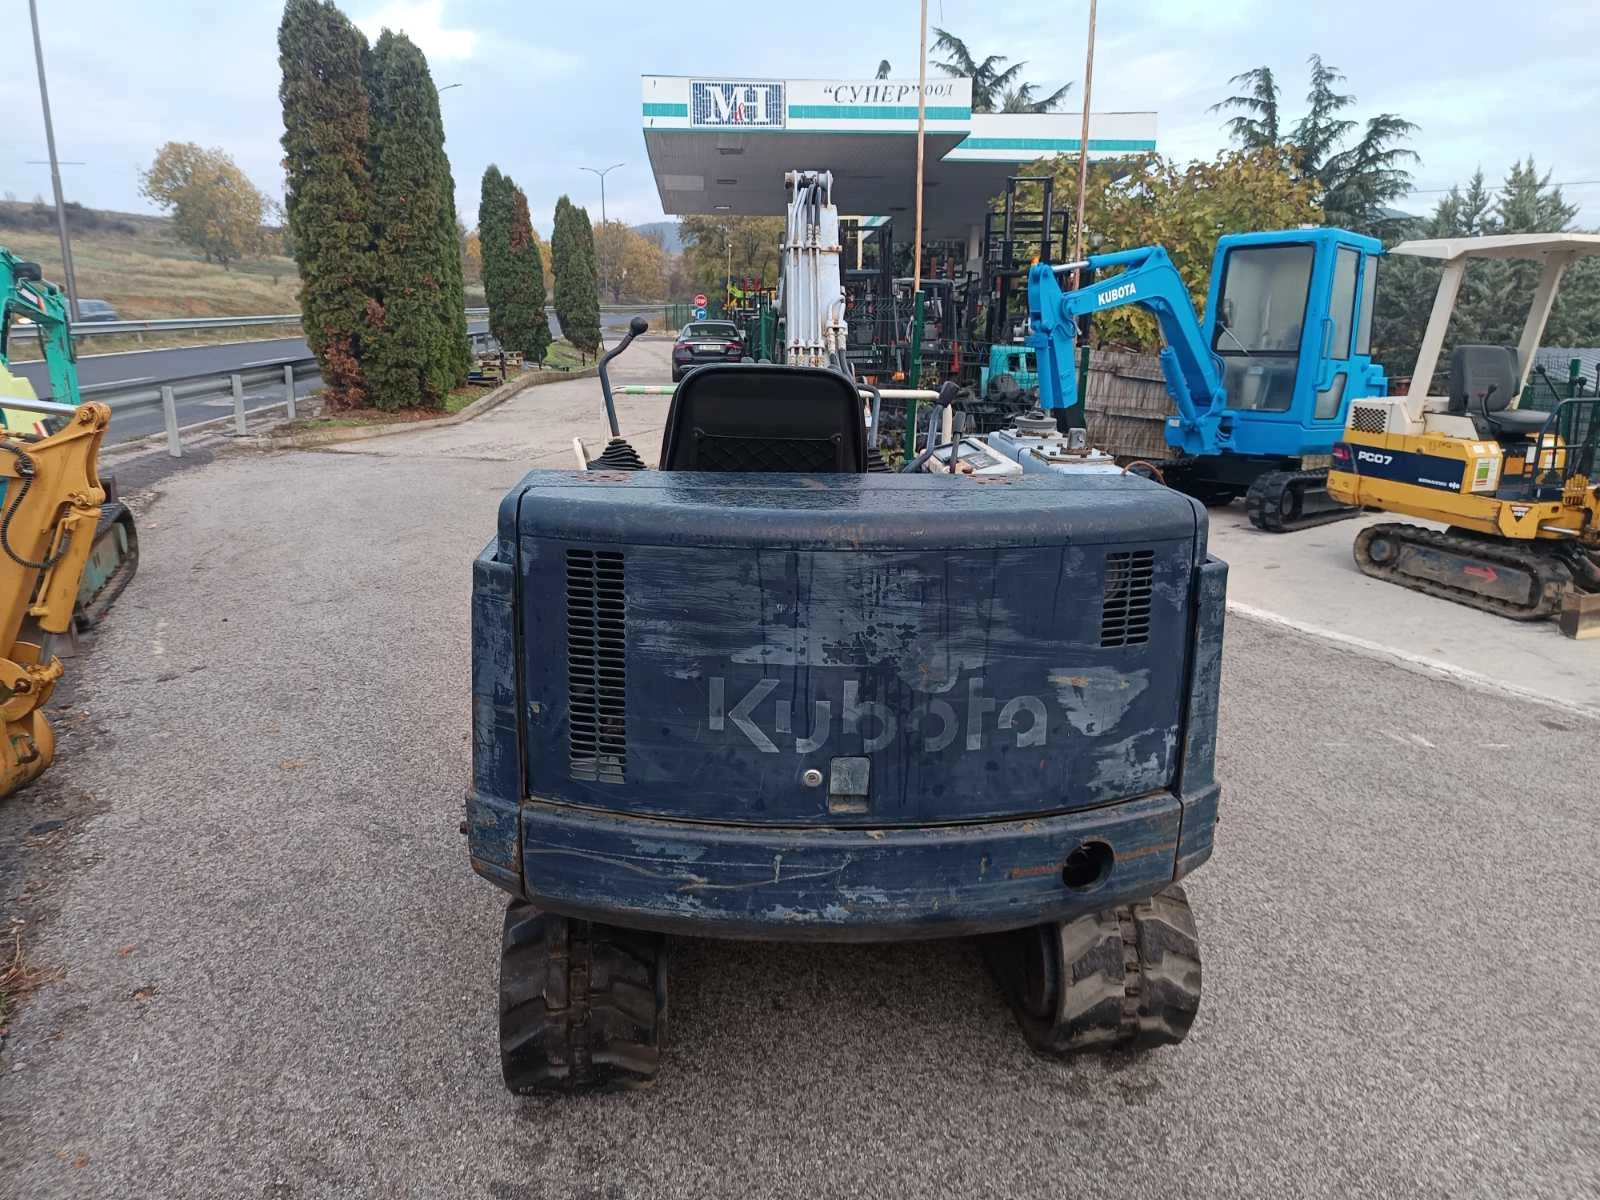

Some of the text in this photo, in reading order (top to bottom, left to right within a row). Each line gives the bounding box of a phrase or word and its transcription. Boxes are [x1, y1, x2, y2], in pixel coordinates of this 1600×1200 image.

[1098, 282, 1136, 306] KUBOTA
[1358, 451, 1392, 464] PC07
[708, 676, 1048, 753] Kubota
